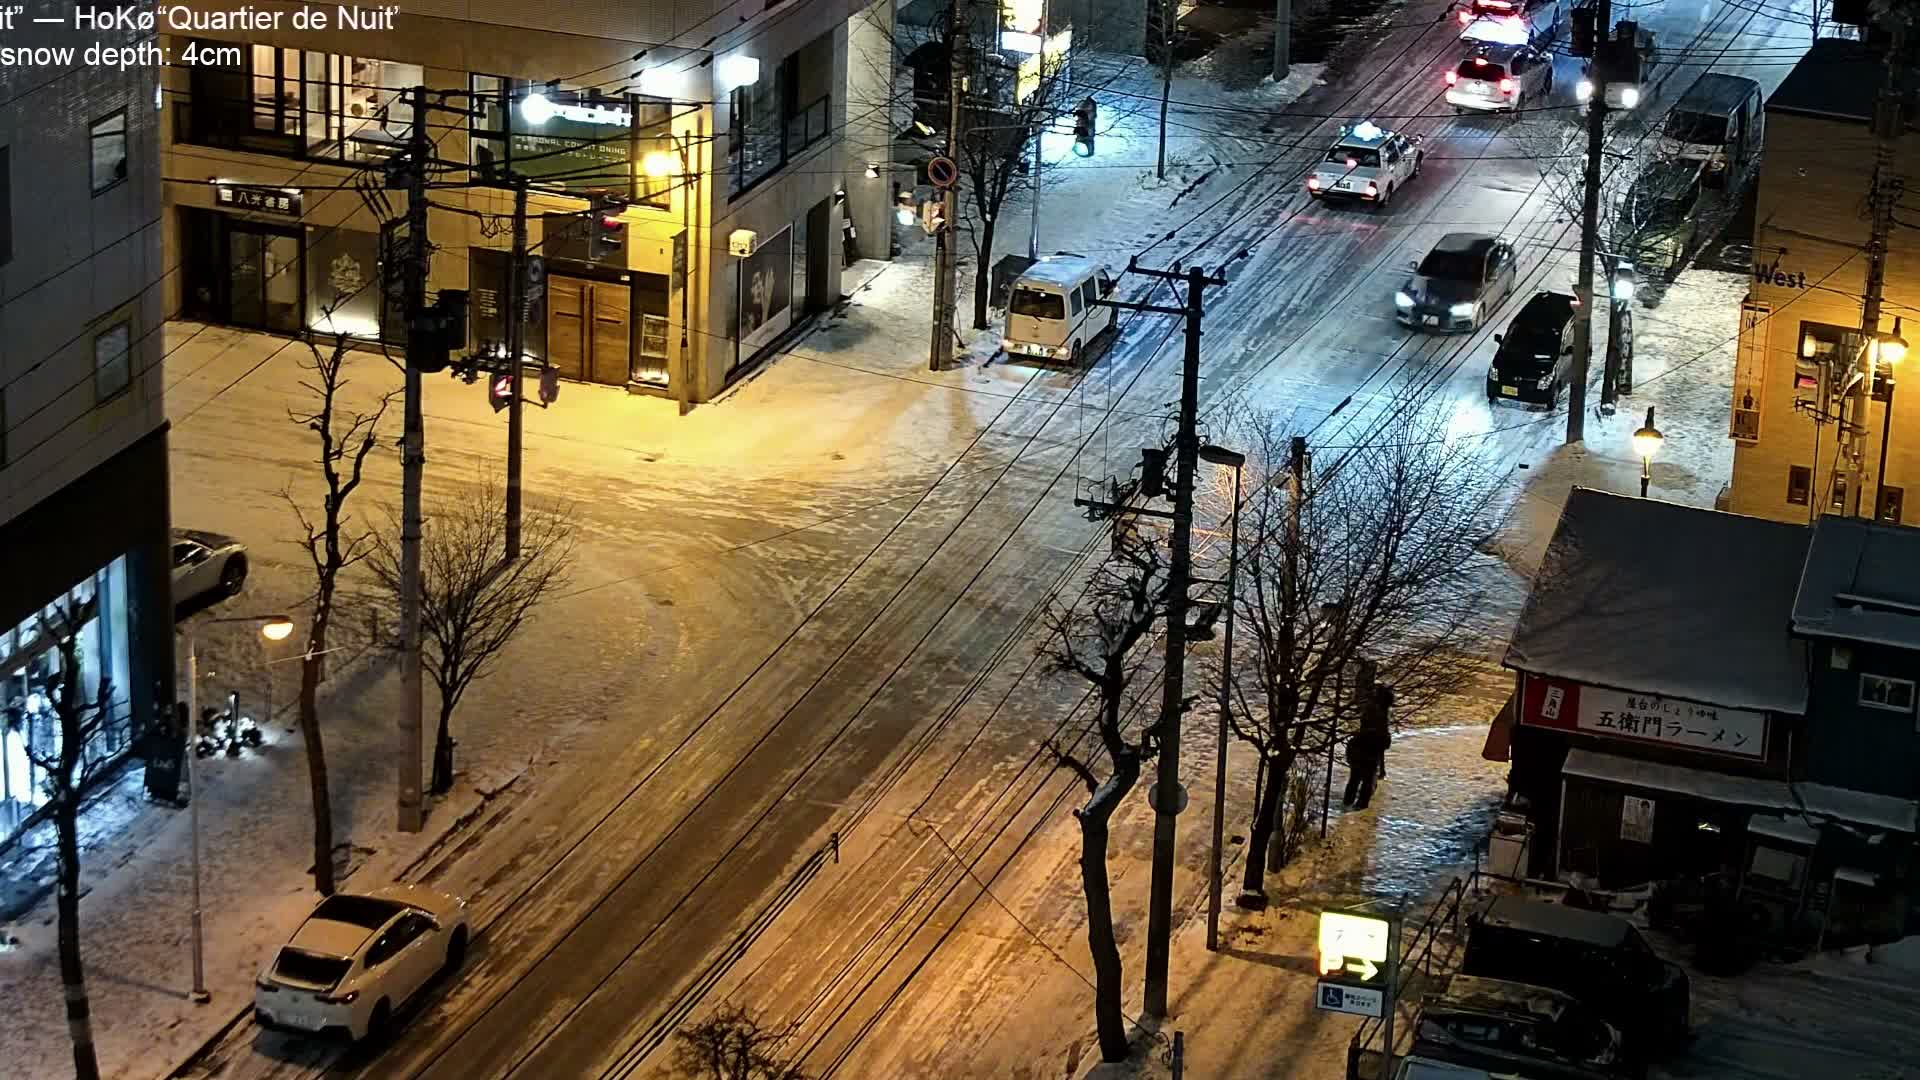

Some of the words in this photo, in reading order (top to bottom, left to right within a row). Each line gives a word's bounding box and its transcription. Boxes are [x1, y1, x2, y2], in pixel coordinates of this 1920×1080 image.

[1754, 264, 1805, 289] West
[1596, 711, 1750, 747] 五衛門ラーメン
